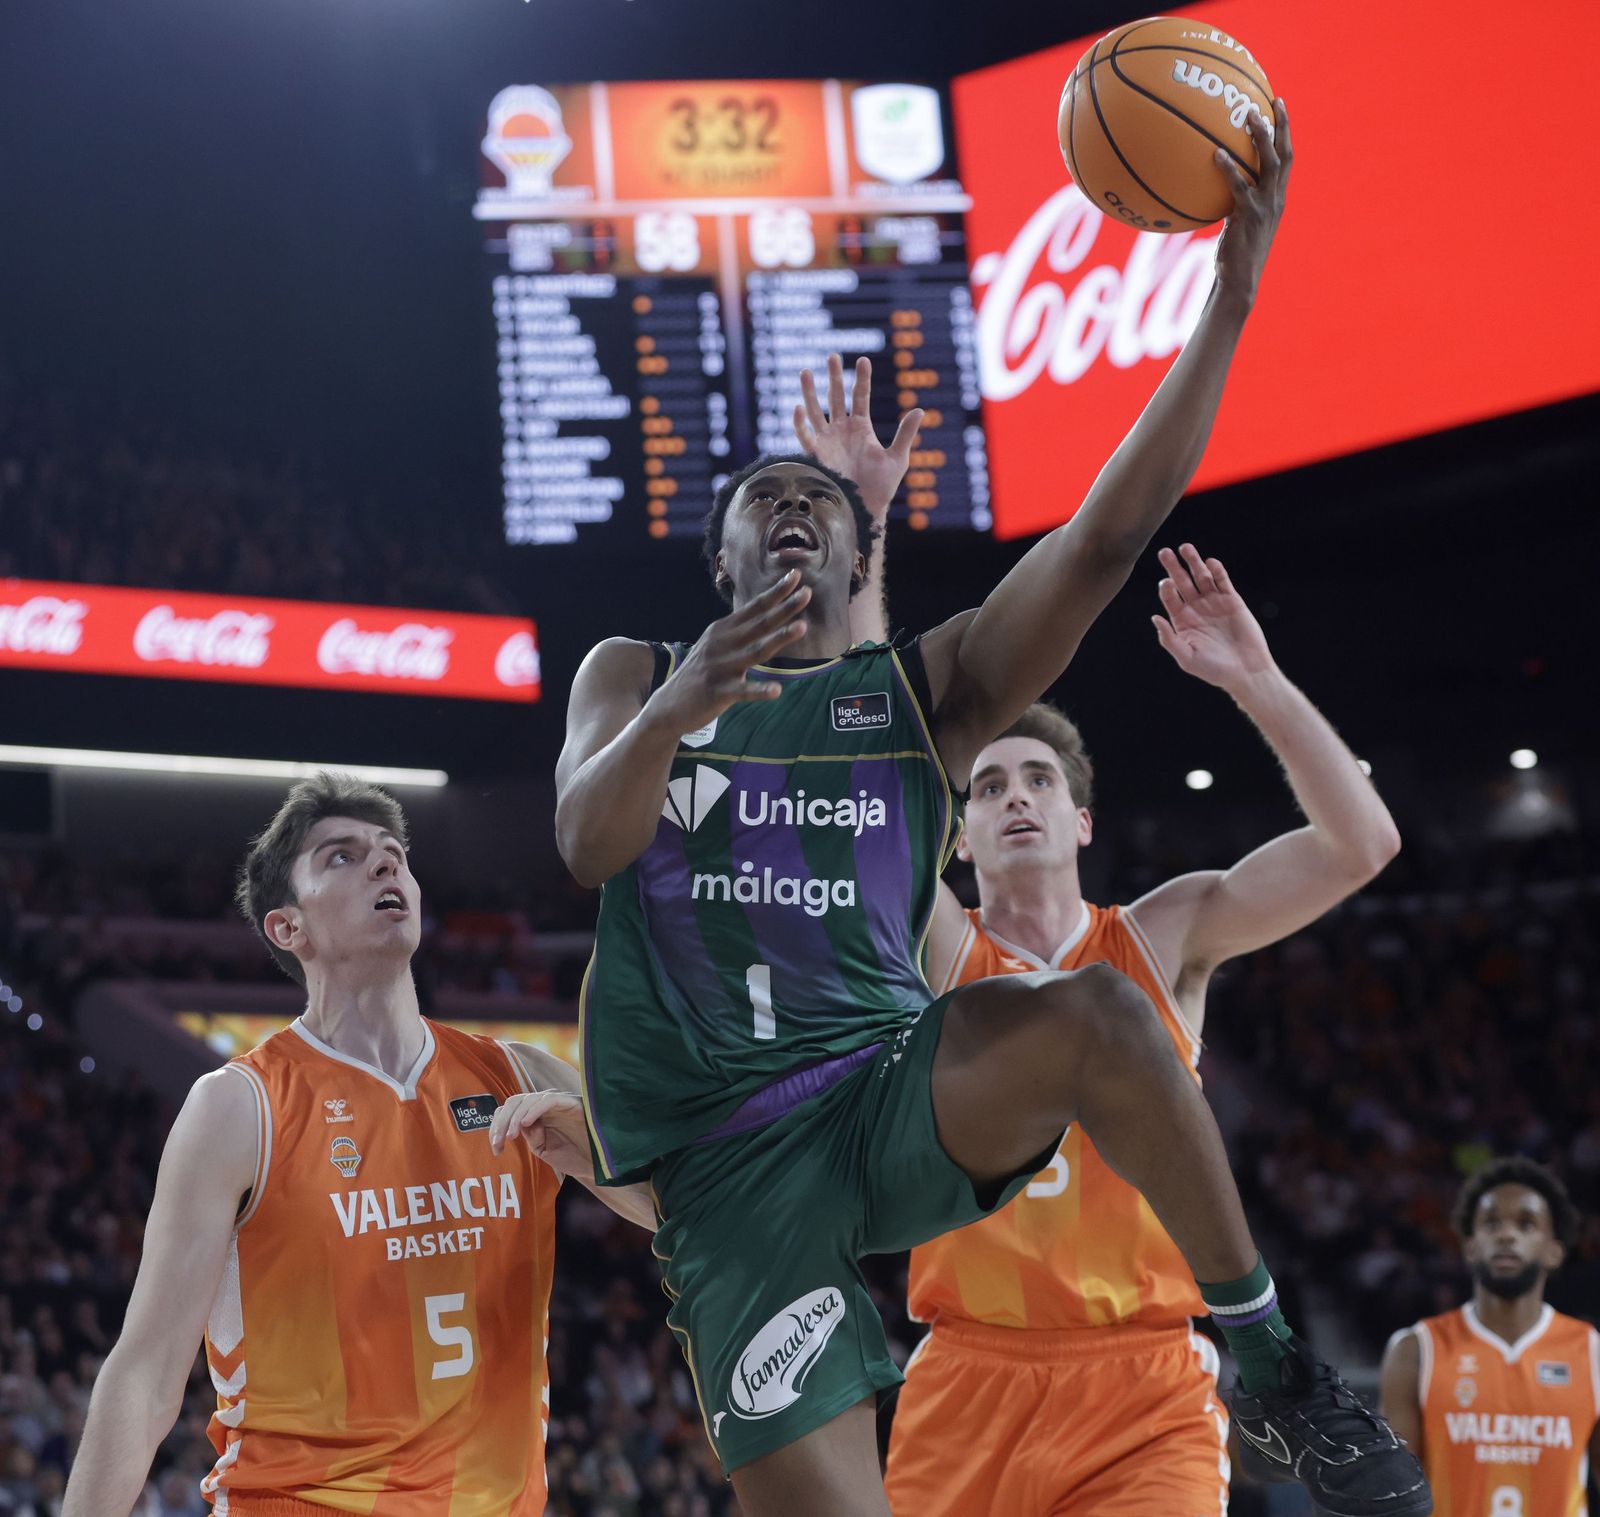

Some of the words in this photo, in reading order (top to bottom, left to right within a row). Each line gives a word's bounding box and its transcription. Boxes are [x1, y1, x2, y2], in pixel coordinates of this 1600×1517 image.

[669, 97, 781, 153] 3:32
[1104, 191, 1148, 227] acb
[838, 706, 860, 718] liga
[838, 714, 887, 726] endesa
[738, 789, 886, 837] Unicaja
[746, 963, 776, 1039] 1
[325, 1113, 354, 1124] hummel
[456, 1107, 478, 1118] liga
[461, 1114, 494, 1127] endes
[329, 1173, 521, 1237] VALENCIA
[385, 1226, 485, 1261] BASKET
[424, 1292, 474, 1380] 5
[739, 1292, 839, 1411] famadesa
[1445, 1412, 1573, 1449] VALENCIA
[1474, 1444, 1543, 1465] BASKET
